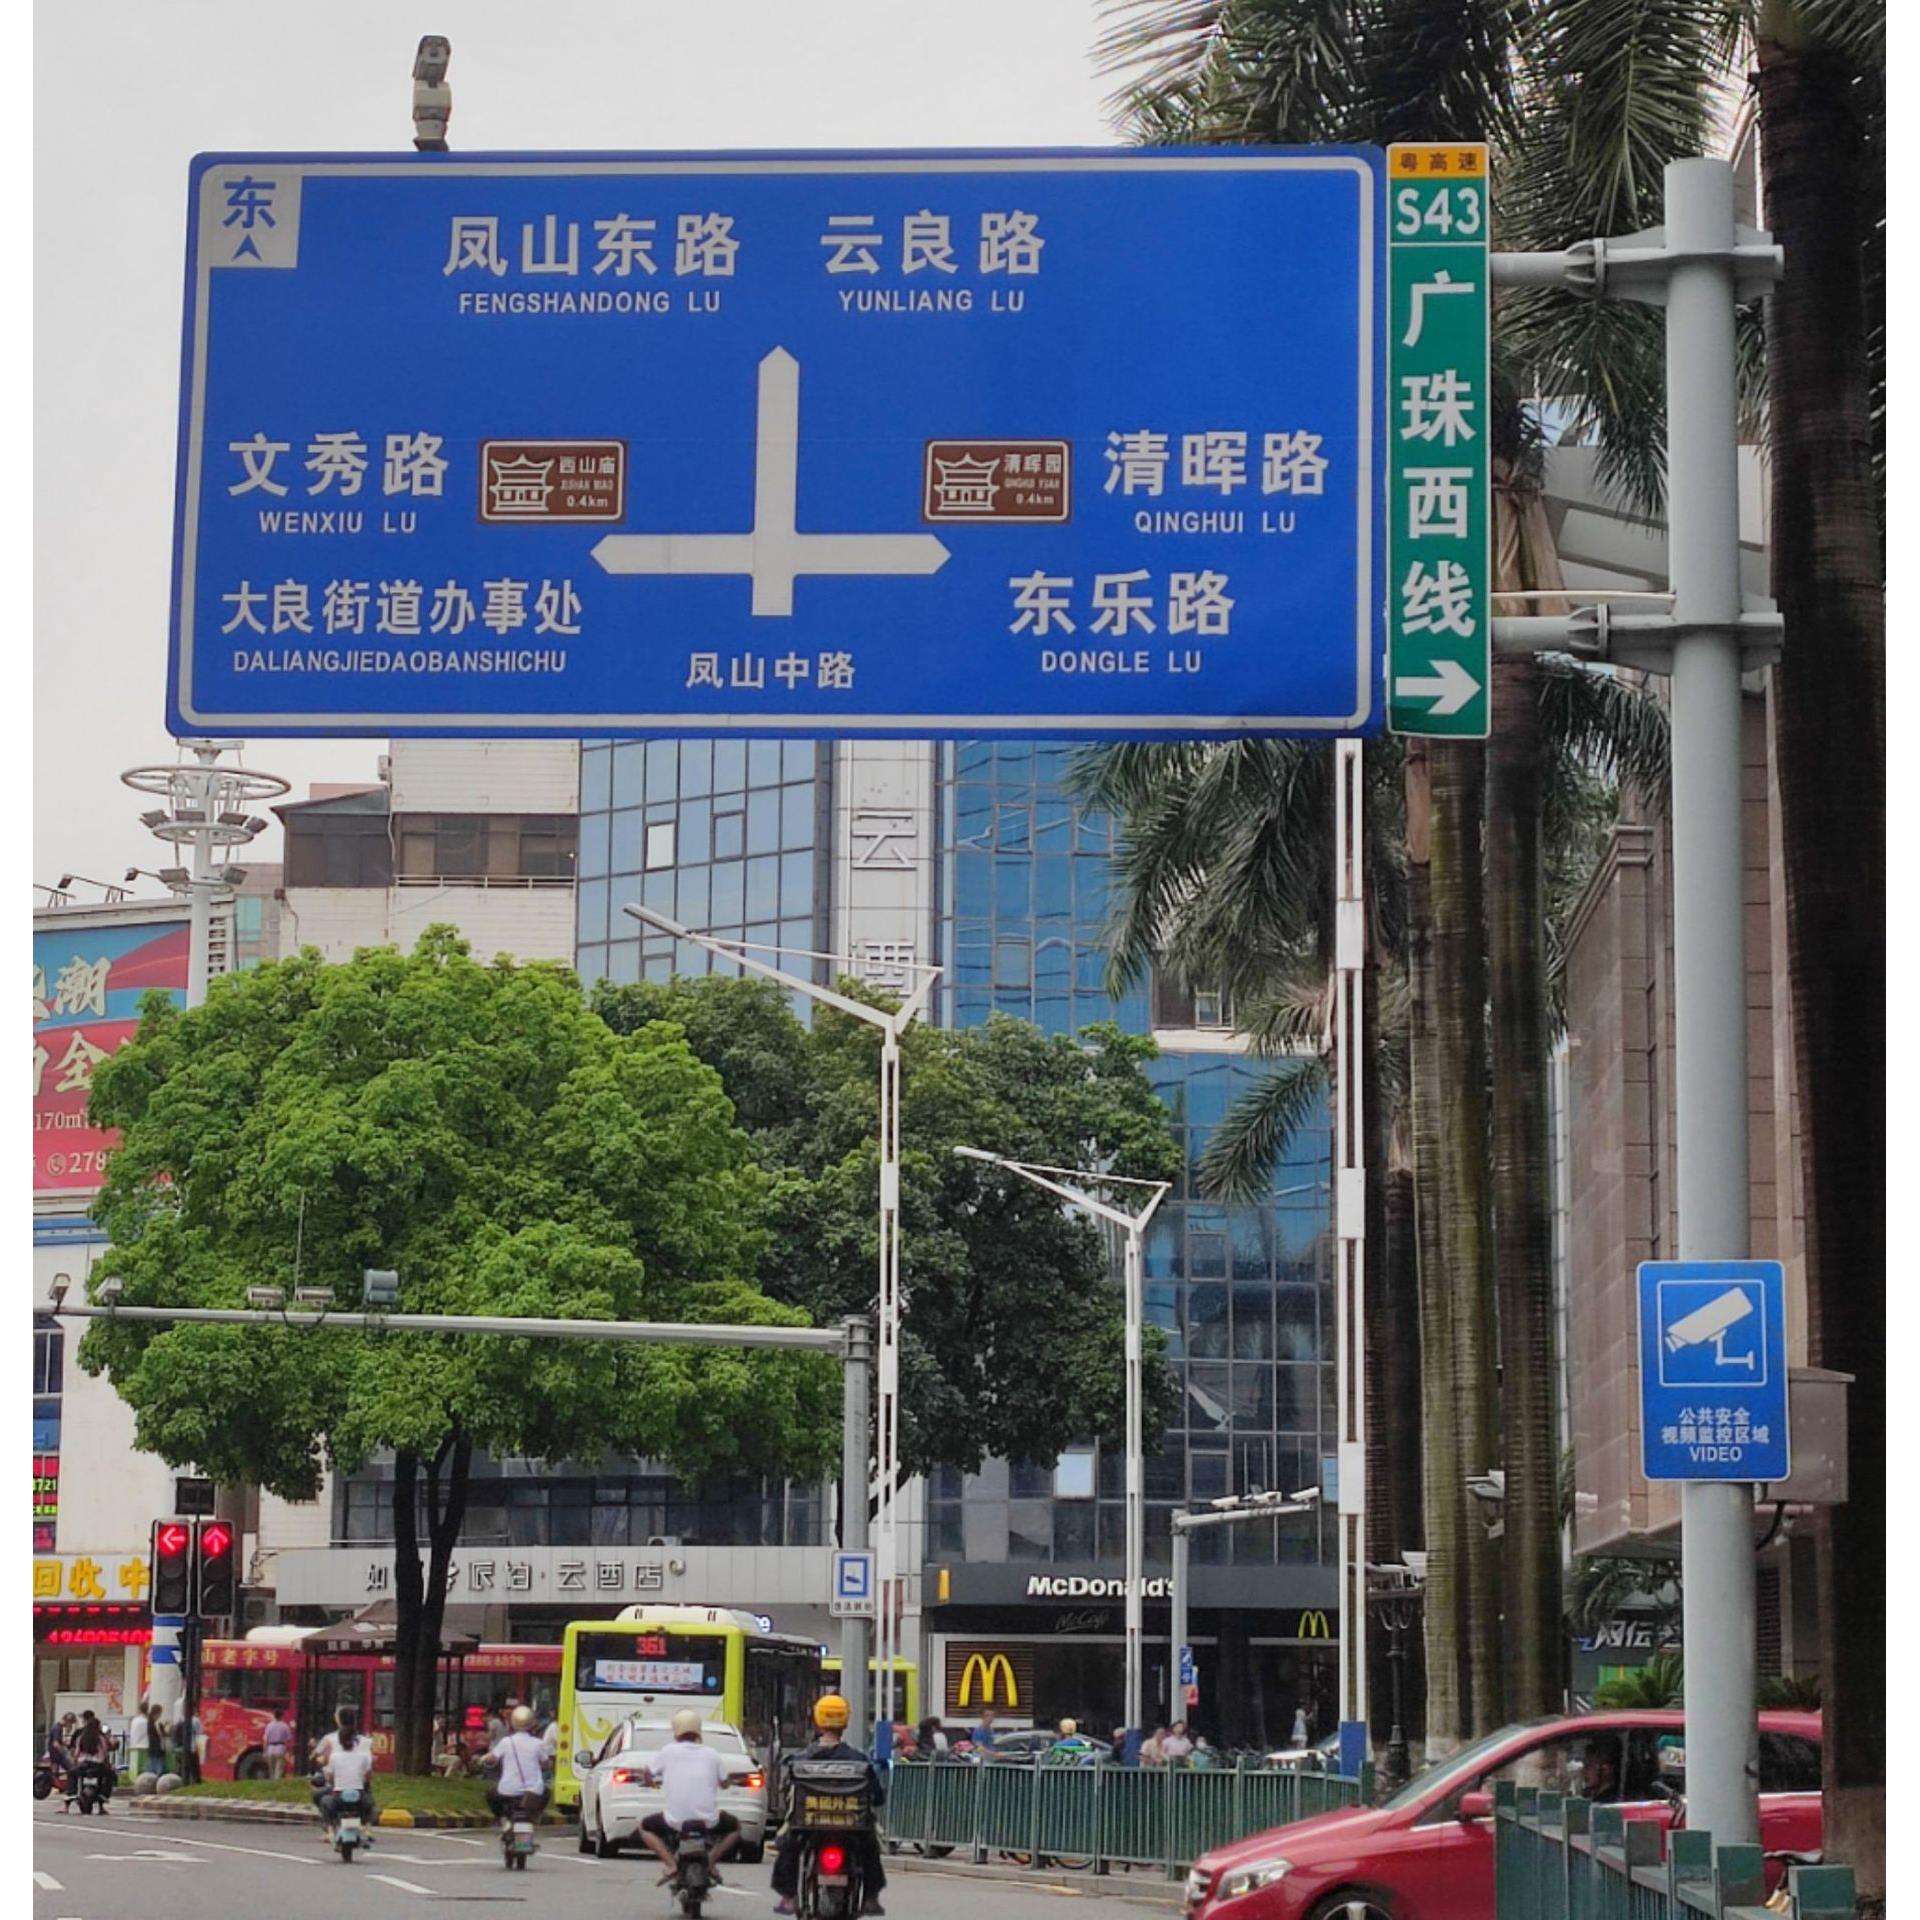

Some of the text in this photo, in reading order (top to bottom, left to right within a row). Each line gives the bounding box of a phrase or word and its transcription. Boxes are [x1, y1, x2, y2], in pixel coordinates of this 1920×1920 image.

[221, 175, 277, 228] 东
[1397, 187, 1480, 235] S43
[443, 212, 740, 277] 凤山东路
[821, 209, 1044, 276] 云良路
[460, 291, 722, 314] FENGSHANDONG LU
[839, 290, 1025, 312] YUNLIANG LU
[228, 431, 448, 497] 文秀路
[1104, 429, 1329, 498] 清晖路
[1401, 270, 1475, 638] 广珠西线
[259, 512, 417, 534] WENXIU LU
[1135, 511, 1296, 534] QINGHUI LU
[221, 577, 582, 636] 大良街道办事处
[1009, 569, 1235, 637] 东乐路
[233, 650, 567, 674] DALIANGJIEDAOBANSHICHU
[686, 651, 855, 690] 凤山中路
[1041, 651, 1201, 674] DONGLE LU
[69, 1150, 114, 1174] 278
[1679, 1407, 1750, 1425] 公共安全
[1662, 1426, 1770, 1444] 视频监控区域
[1689, 1446, 1743, 1462] VIDEO
